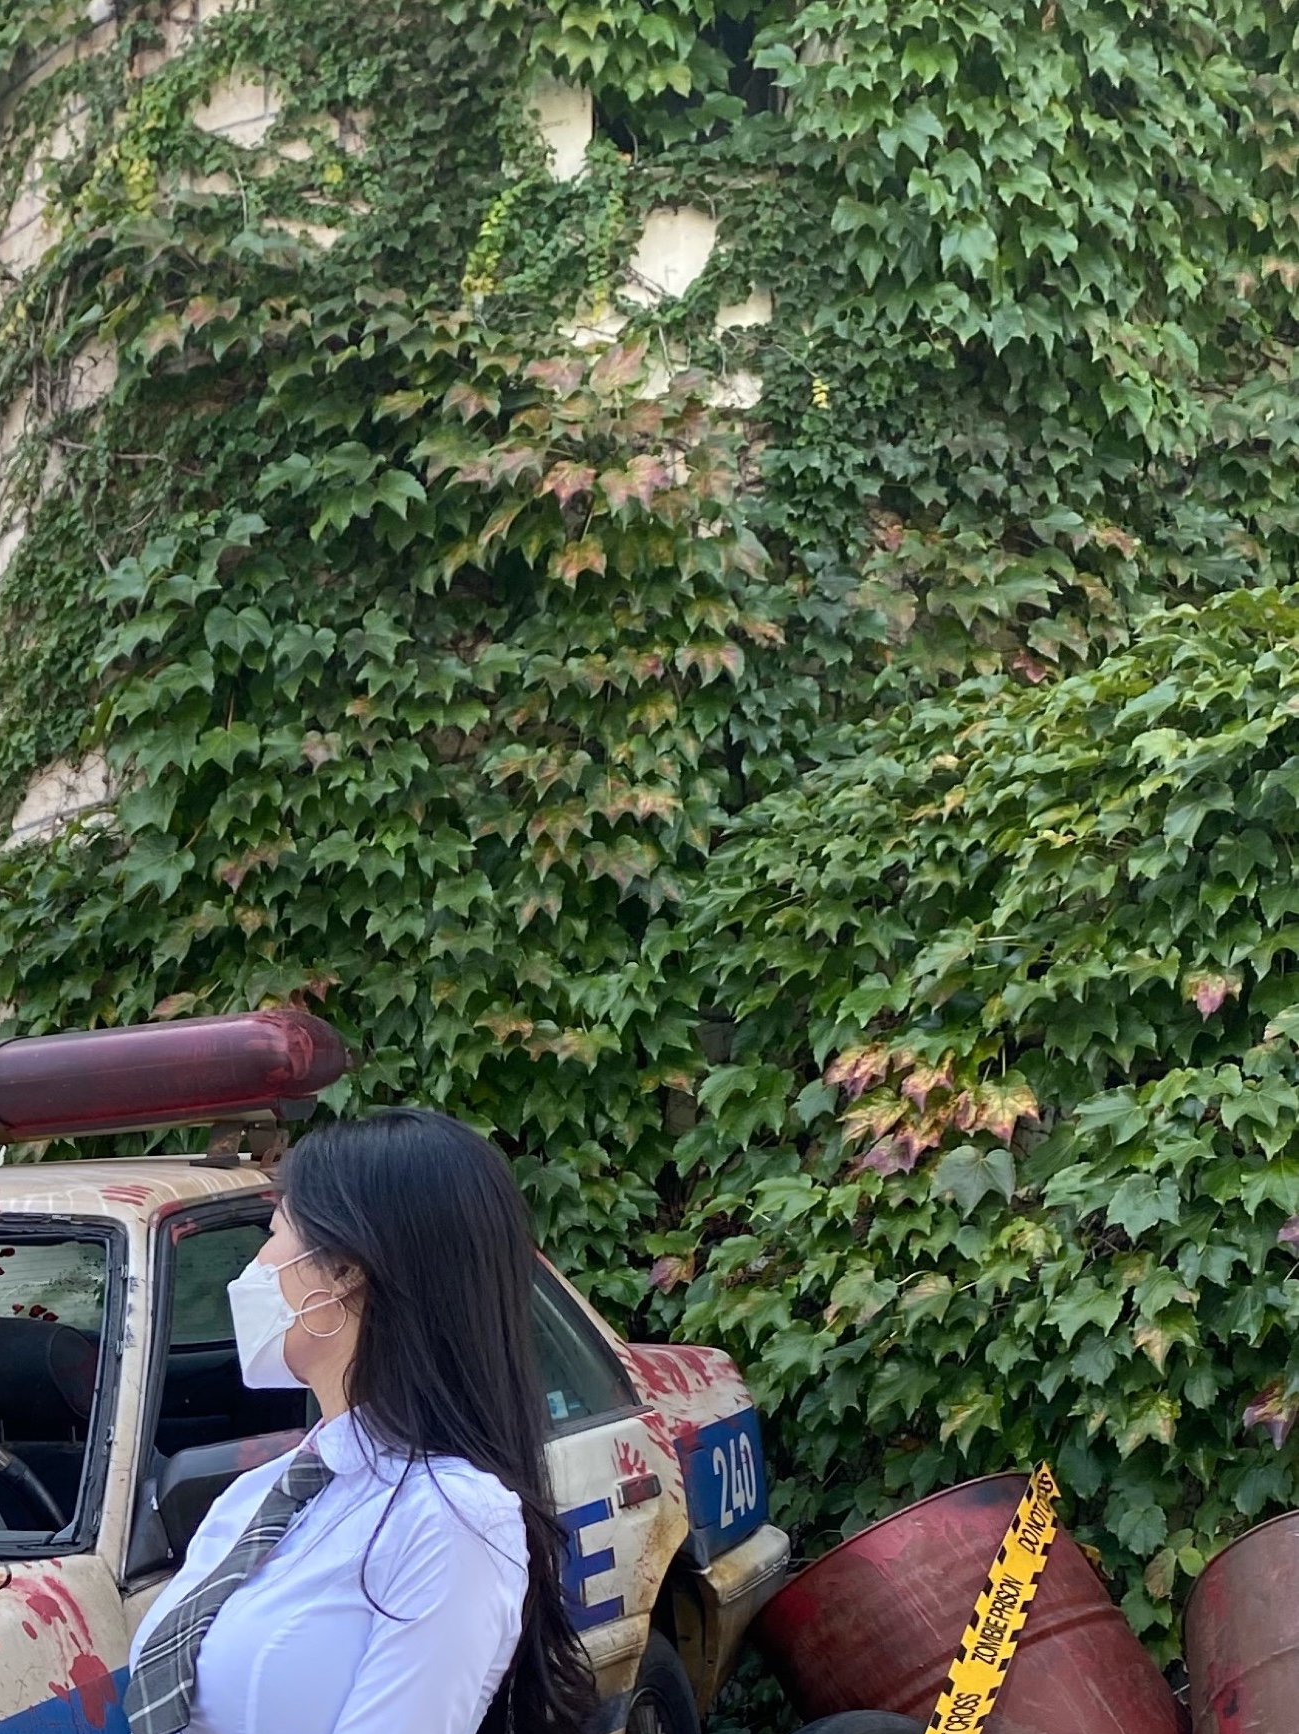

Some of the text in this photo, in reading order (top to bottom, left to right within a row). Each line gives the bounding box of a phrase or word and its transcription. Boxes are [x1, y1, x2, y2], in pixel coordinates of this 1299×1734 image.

[713, 1432, 756, 1528] 240
[1018, 1528, 1040, 1554] DO
[971, 1573, 1024, 1666] ZOMBIE PRISON
[944, 1693, 981, 1731] CROSS
